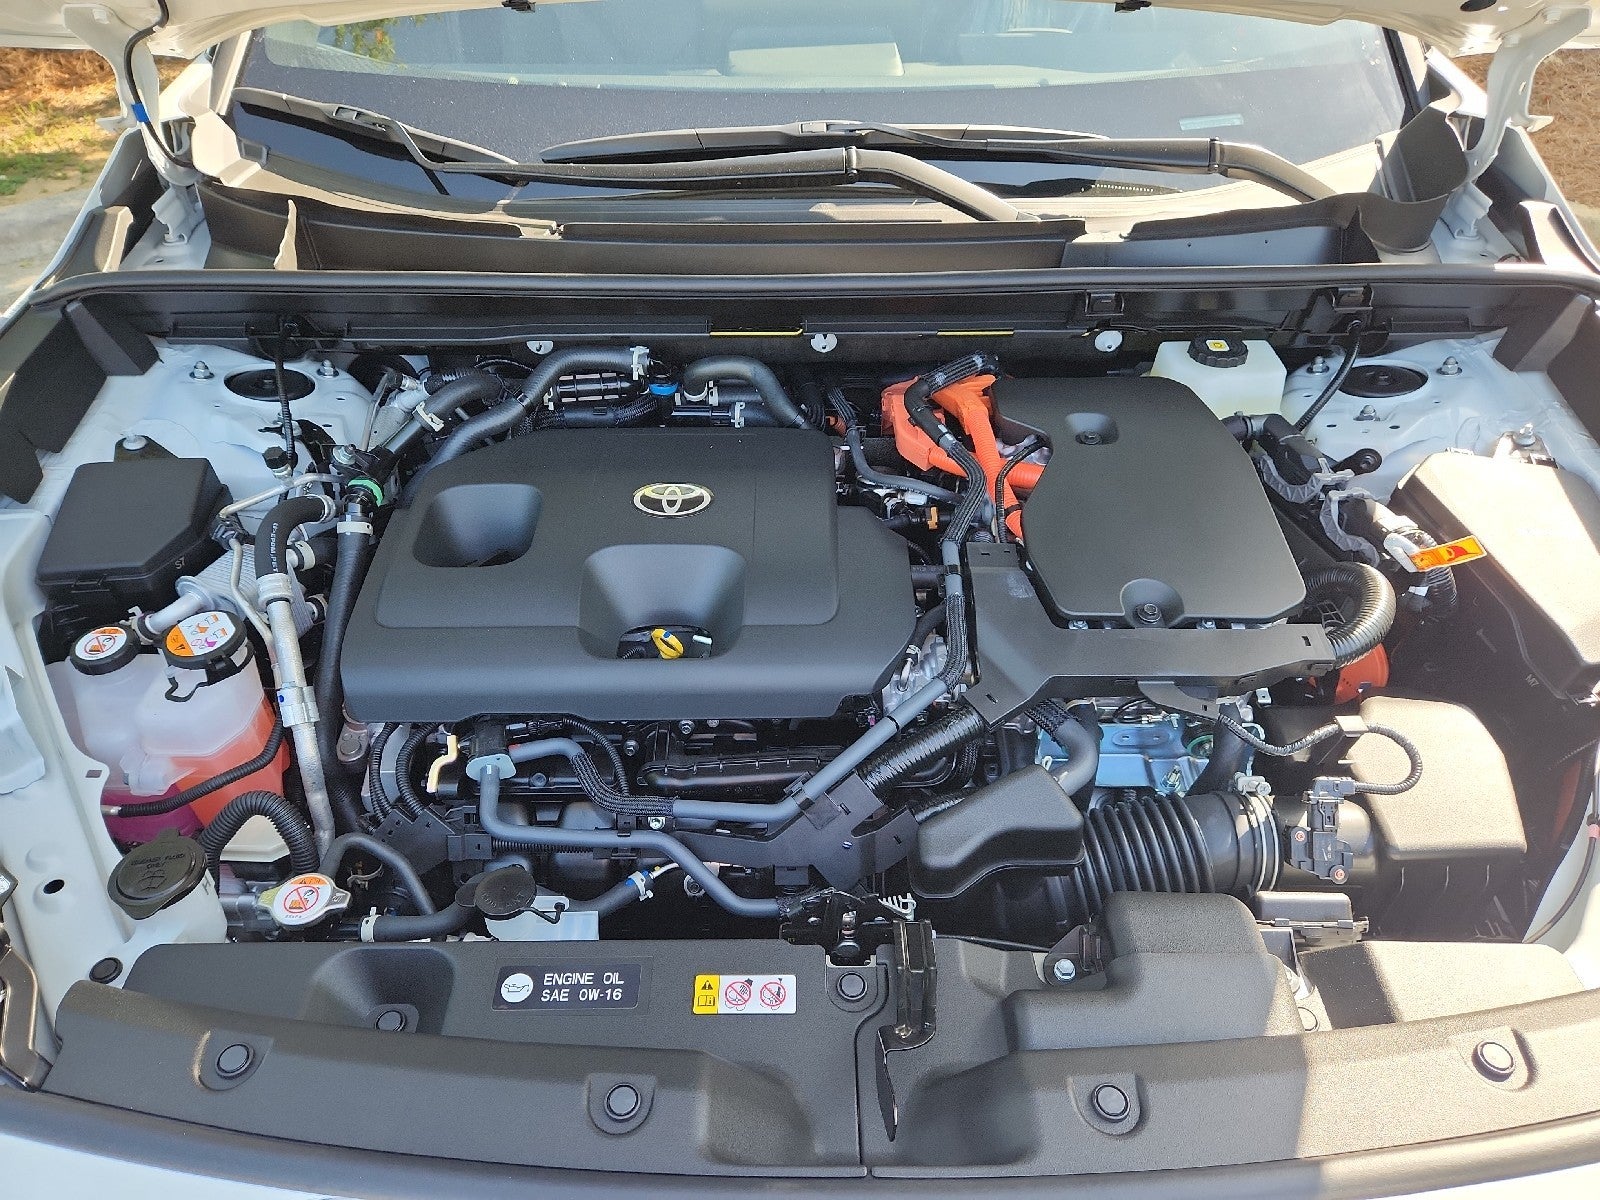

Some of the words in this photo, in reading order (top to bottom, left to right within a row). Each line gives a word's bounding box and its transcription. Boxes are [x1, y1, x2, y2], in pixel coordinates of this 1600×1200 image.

[543, 972, 595, 986] ENGINE
[603, 972, 625, 985] OIL
[541, 988, 570, 1002] SAE
[579, 988, 623, 1001] 0W-16
